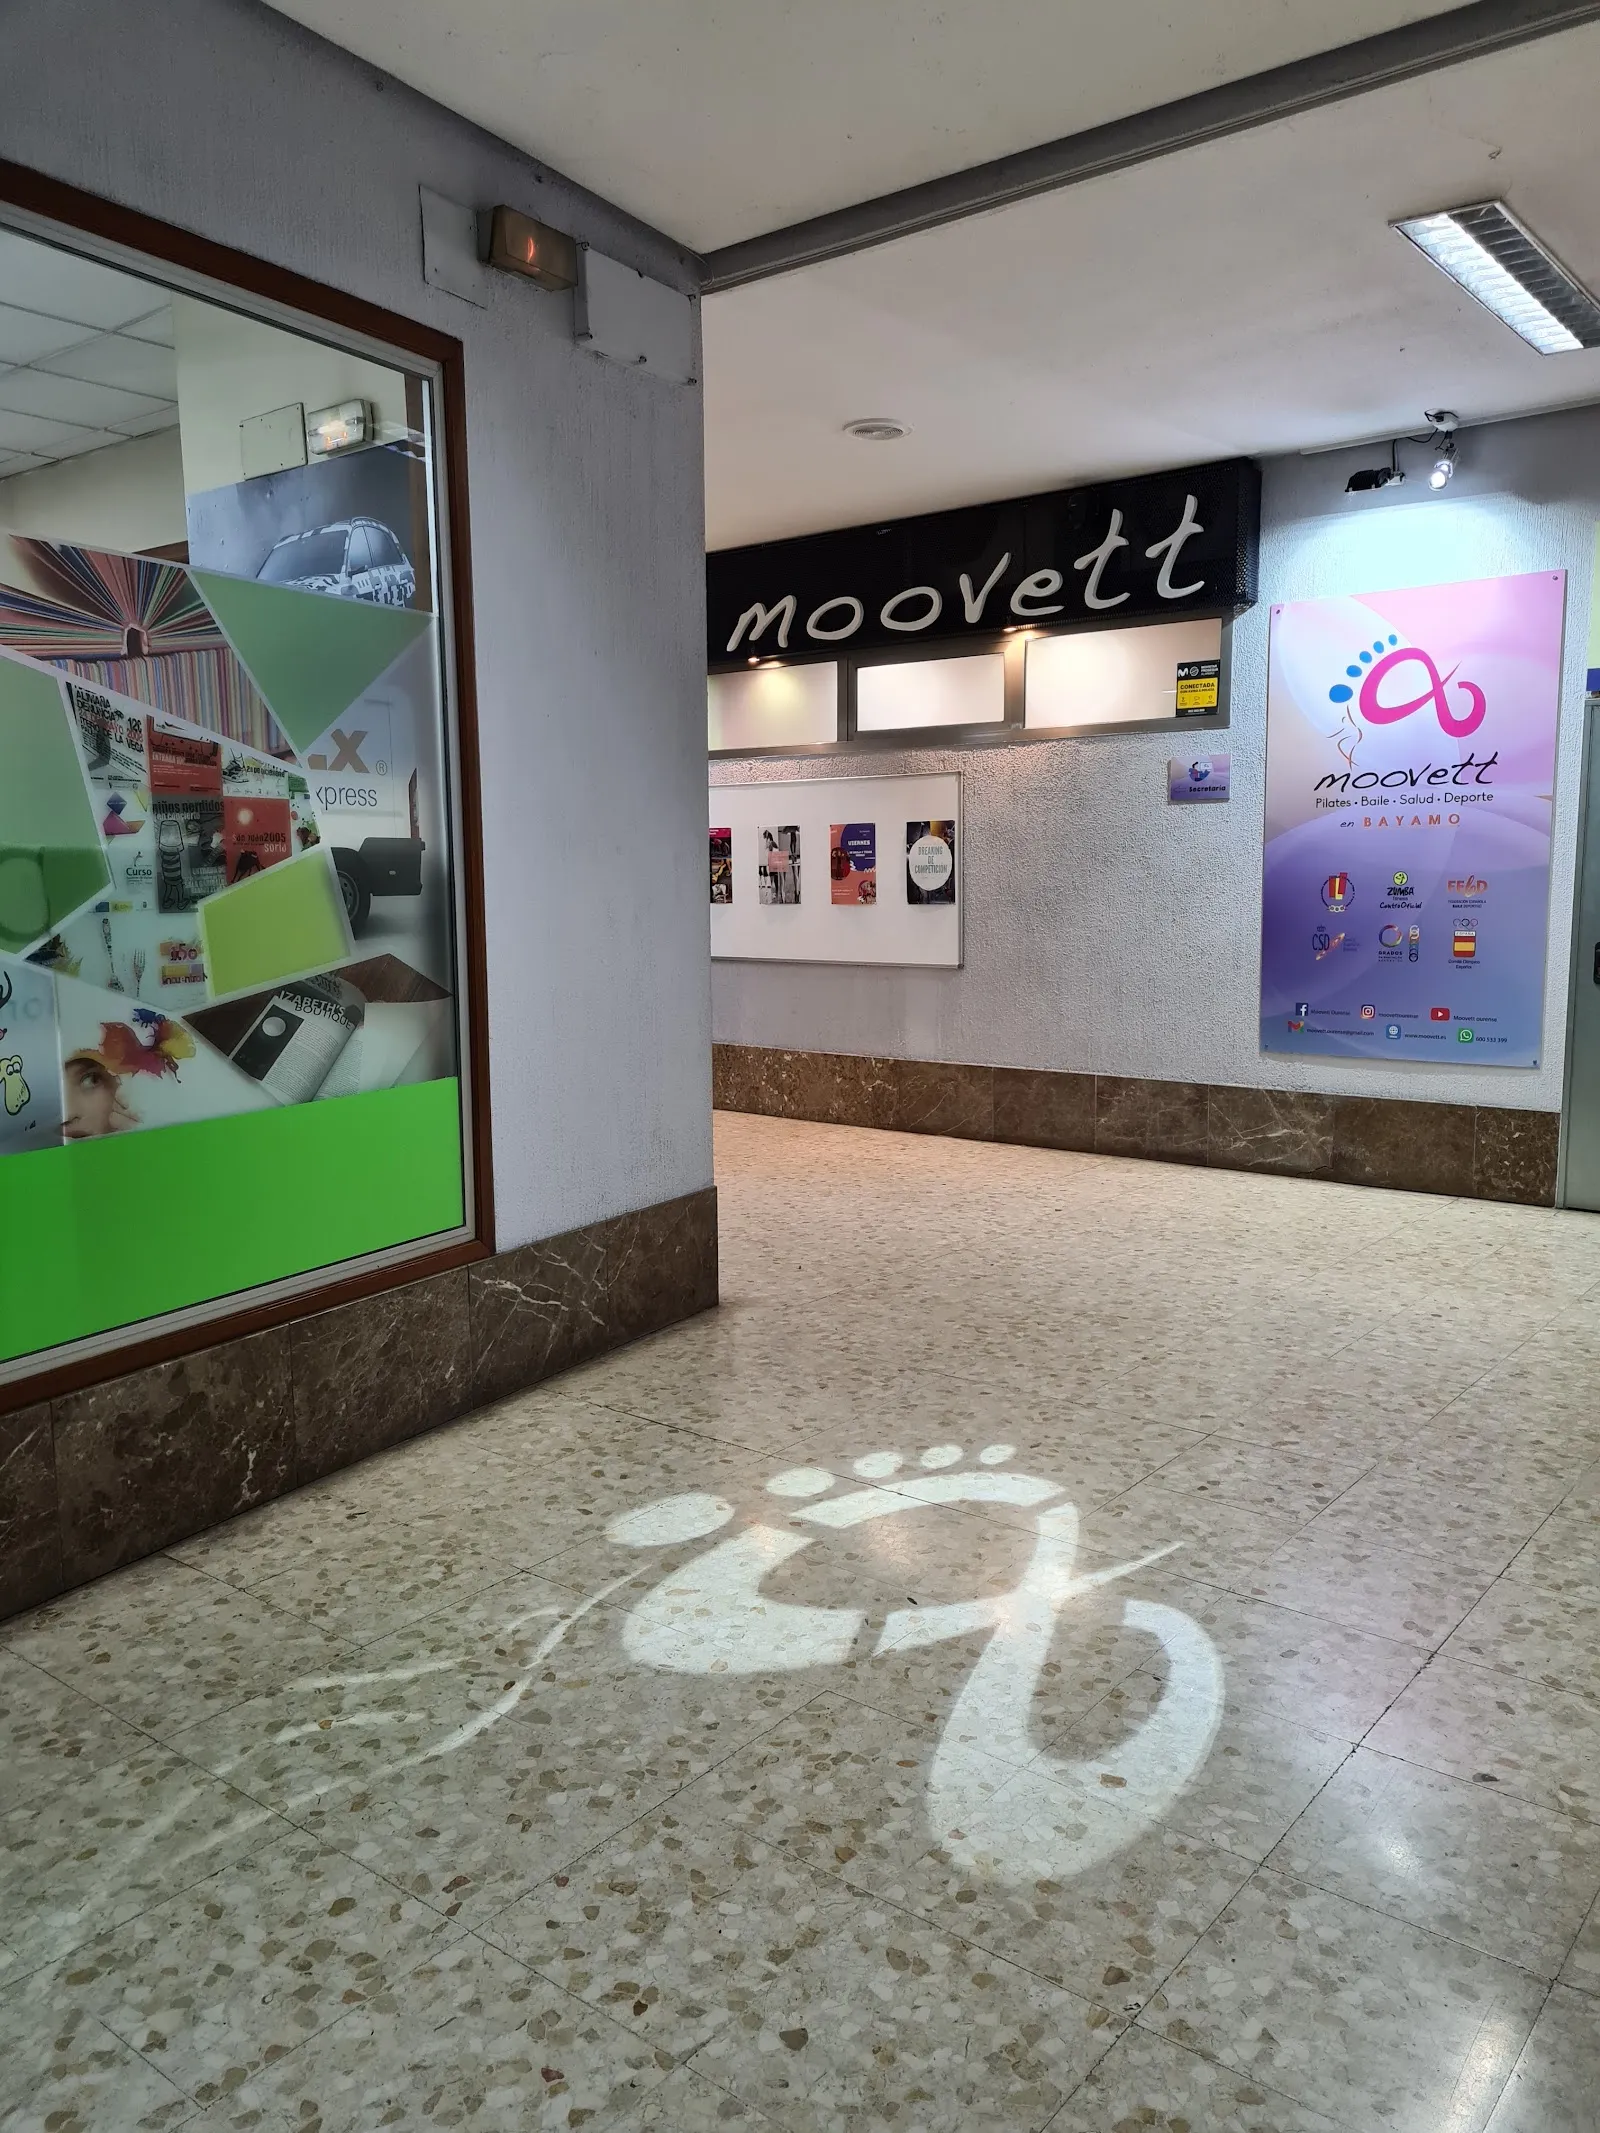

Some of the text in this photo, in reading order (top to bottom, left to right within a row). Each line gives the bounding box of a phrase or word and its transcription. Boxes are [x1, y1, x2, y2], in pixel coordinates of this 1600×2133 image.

[727, 494, 1205, 652] moovett
[1180, 682, 1216, 690] CONECTADA
[1313, 751, 1499, 793] moovett
[1315, 791, 1494, 809] Pilates Baile Salud Deporte
[1363, 813, 1460, 828] BAYAMO
[126, 866, 153, 876] Curso
[294, 1002, 352, 1030] BOUTIQUE
